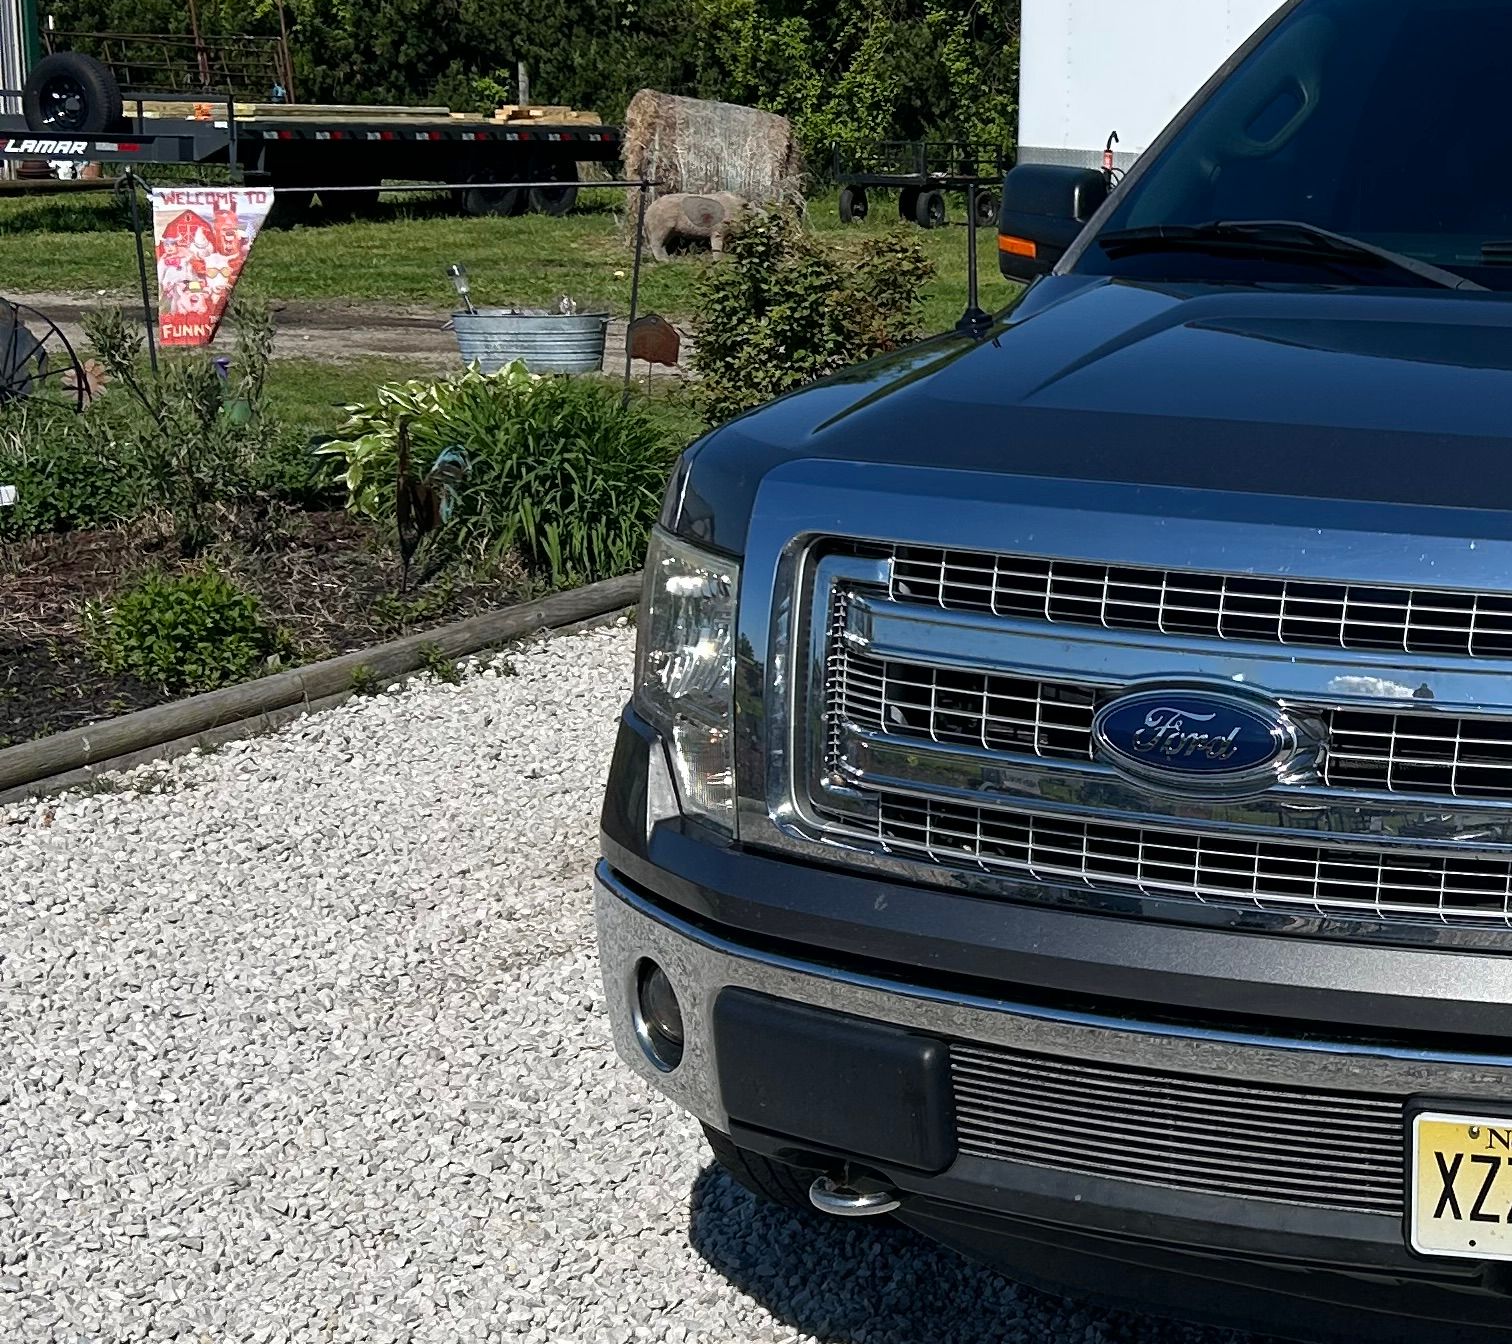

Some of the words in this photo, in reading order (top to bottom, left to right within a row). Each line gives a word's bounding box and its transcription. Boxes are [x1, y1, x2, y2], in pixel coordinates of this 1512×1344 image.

[4, 139, 88, 154] LAMAR
[159, 191, 238, 205] WELCOME
[244, 191, 267, 204] TO
[162, 323, 216, 338] FUNNY
[1132, 706, 1242, 760] Ford
